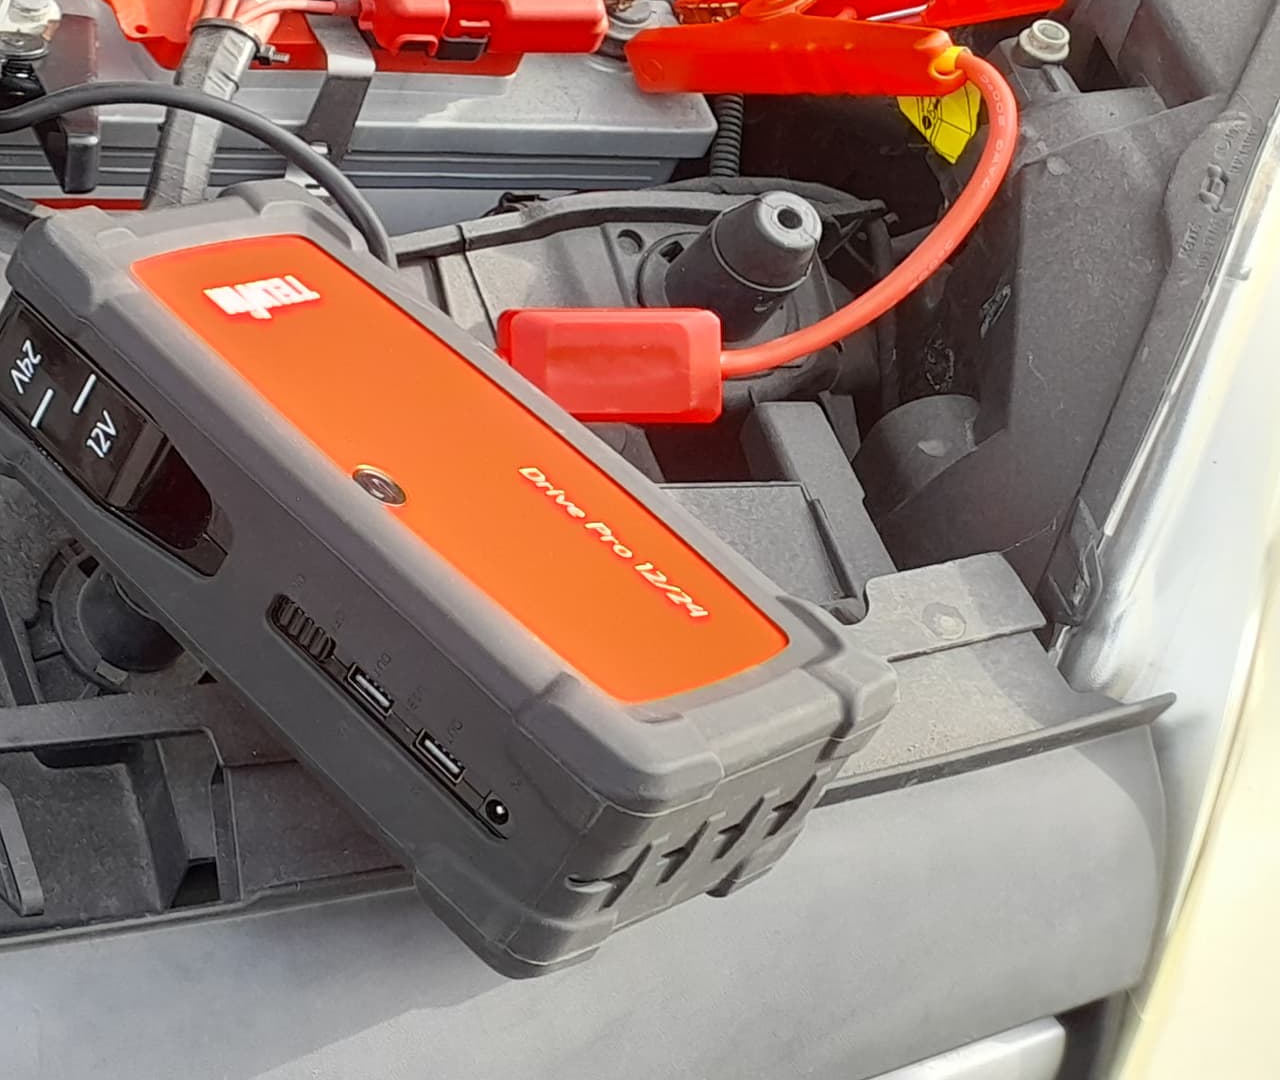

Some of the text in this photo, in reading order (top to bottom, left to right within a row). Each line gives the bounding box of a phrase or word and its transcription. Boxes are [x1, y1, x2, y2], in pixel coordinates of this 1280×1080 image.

[10, 339, 42, 395] 24V
[86, 409, 118, 459] 12V
[518, 467, 710, 618] Drive Pro 12/24
